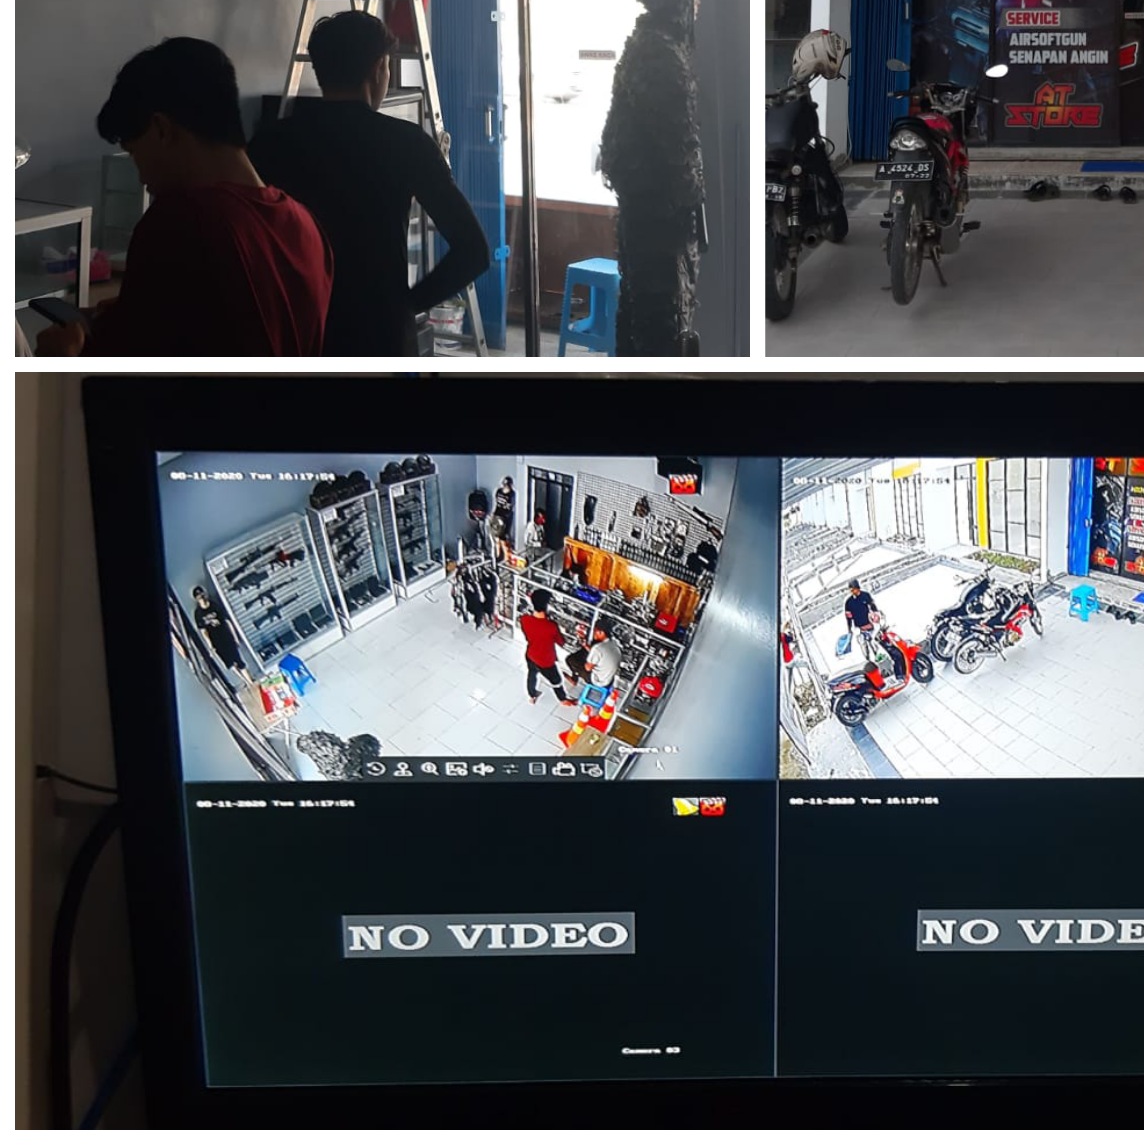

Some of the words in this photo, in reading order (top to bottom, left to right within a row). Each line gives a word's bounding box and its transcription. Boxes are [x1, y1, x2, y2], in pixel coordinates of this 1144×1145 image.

[1006, 11, 1060, 26] SERVICE
[1010, 32, 1087, 46] AIRSOFTGUN
[1009, 50, 1067, 64] SENAPAN
[1070, 50, 1108, 64] ANGIN
[1034, 81, 1075, 106] AT
[1005, 103, 1103, 128] STORE
[348, 923, 430, 951] NO
[447, 922, 629, 950] VIDEO
[921, 918, 1000, 945] NO
